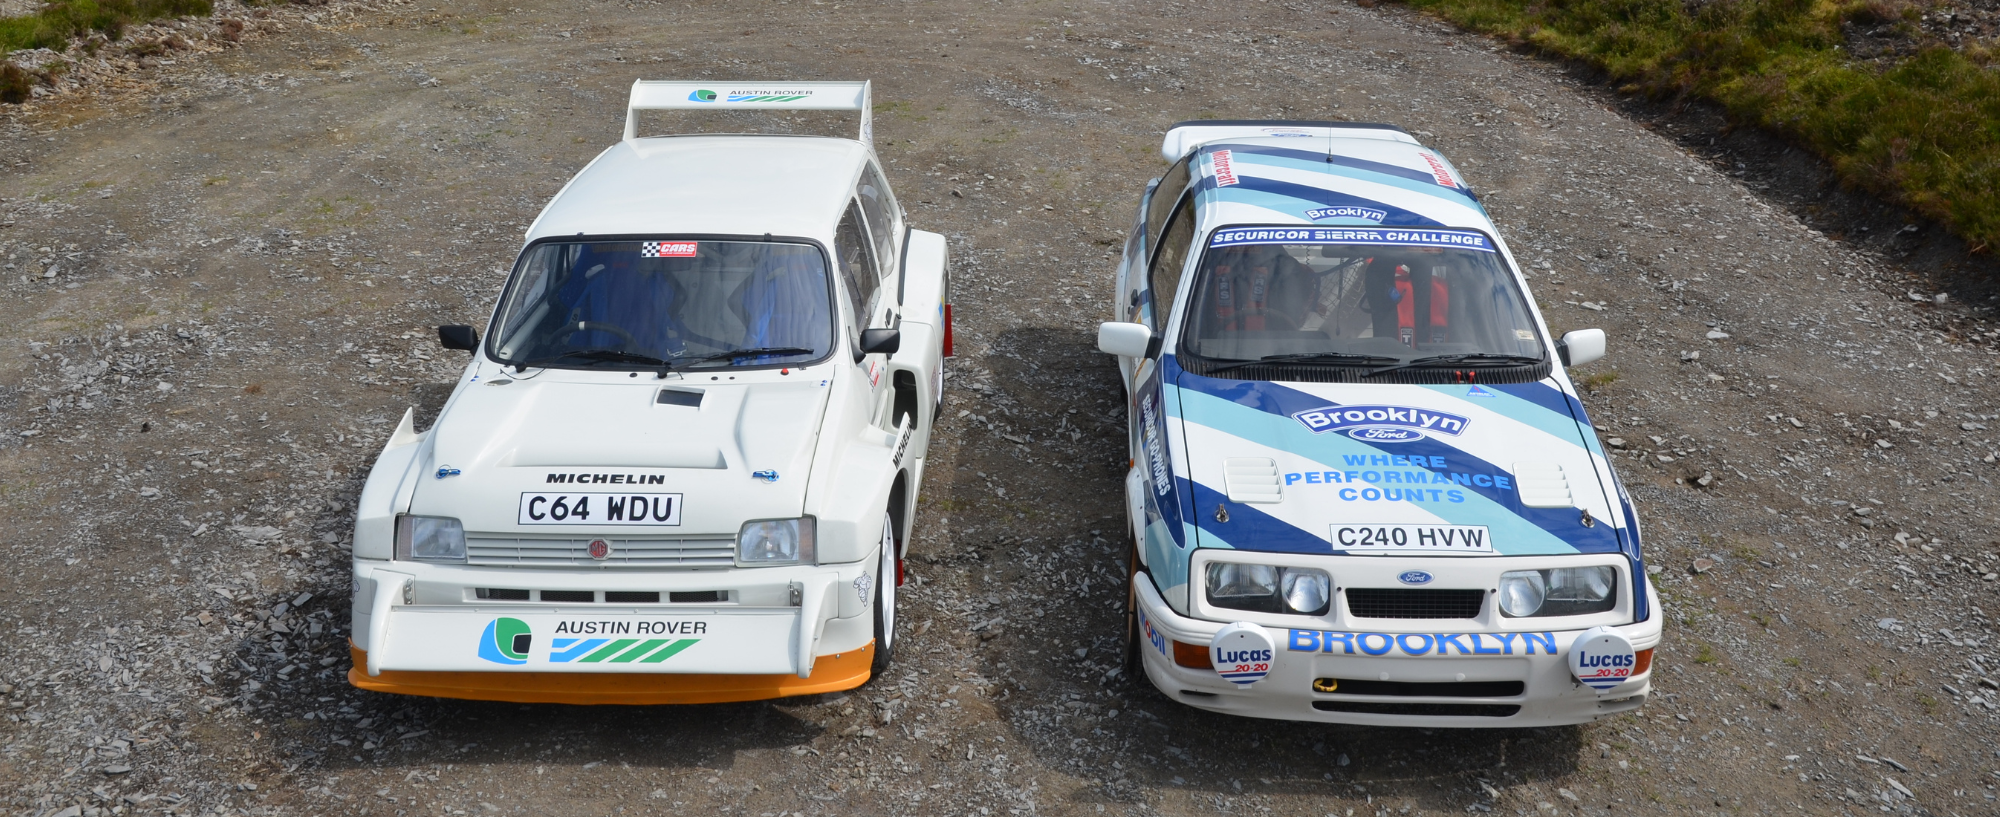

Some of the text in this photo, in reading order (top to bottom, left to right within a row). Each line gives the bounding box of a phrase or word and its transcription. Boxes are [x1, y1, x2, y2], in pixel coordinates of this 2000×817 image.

[1212, 150, 1236, 187] Motorcraft
[1418, 152, 1457, 188] Motorcraft
[1306, 207, 1383, 222] Brooklyn
[1213, 230, 1310, 243] SECURICOR
[1386, 231, 1483, 246] CHALLENGE
[660, 243, 696, 253] CARS
[1300, 407, 1463, 432] Brooklyn
[1365, 428, 1408, 439] Ford
[892, 420, 914, 470] MICHELIN
[1142, 393, 1171, 496] SECURICOR GO-PHONES
[1342, 454, 1448, 468] WHERE
[546, 473, 666, 485] MICHELIN
[1284, 470, 1512, 490] PERFORMANCE
[1338, 487, 1465, 503] COUNTS
[528, 495, 673, 522] C64 WDU
[1337, 527, 1483, 548] C240 HVW
[590, 541, 607, 557] MG
[1405, 572, 1426, 582] Ford
[555, 621, 707, 635] AUSTIN ROVER
[1140, 607, 1166, 656] Mobil
[1287, 629, 1558, 656] BROOKLYN
[1216, 647, 1272, 663] Lucas
[1579, 651, 1633, 668] Lucas
[1235, 663, 1269, 672] 20-20
[1596, 668, 1629, 678] 20-20
